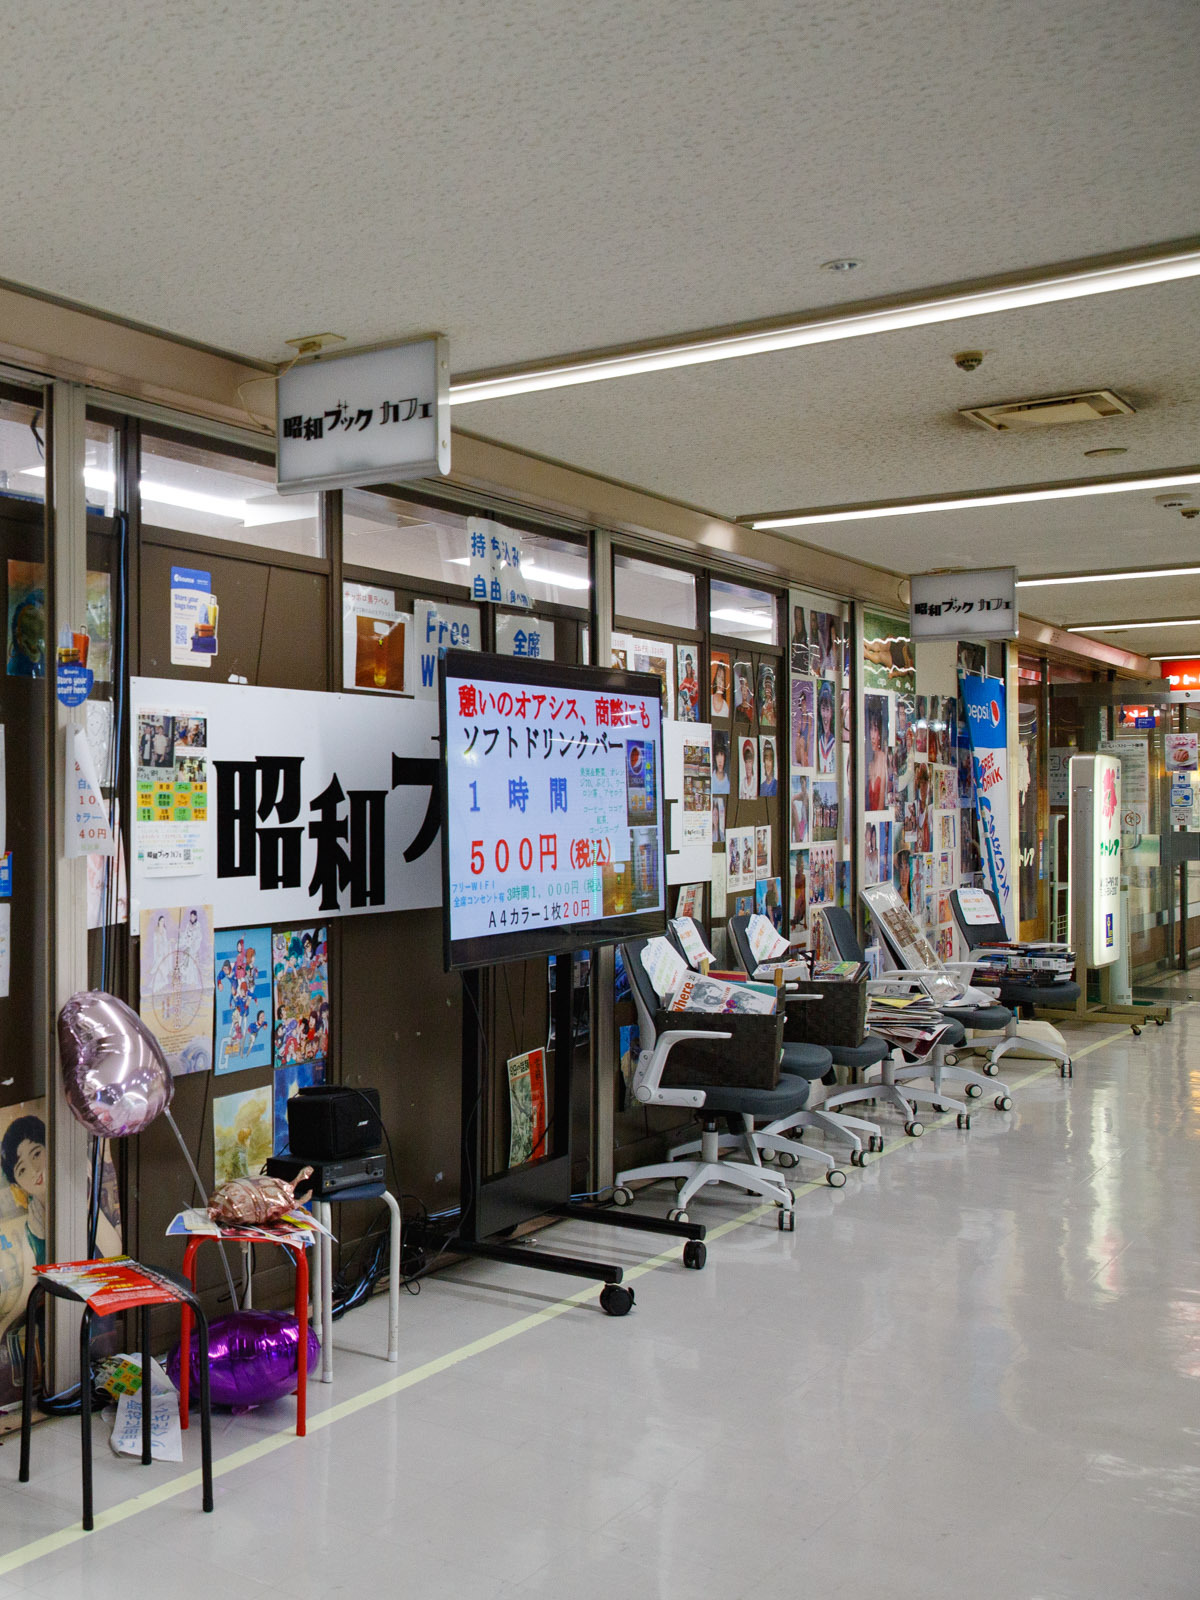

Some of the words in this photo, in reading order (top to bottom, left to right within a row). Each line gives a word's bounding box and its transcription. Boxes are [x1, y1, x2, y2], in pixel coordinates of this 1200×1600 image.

[426, 611, 471, 646] Free
[458, 684, 650, 728] 憩いのオアシス、商談にも
[967, 703, 989, 721] pepsi
[464, 726, 624, 760] ソフトドリンクバー
[79, 828, 107, 839] 40円
